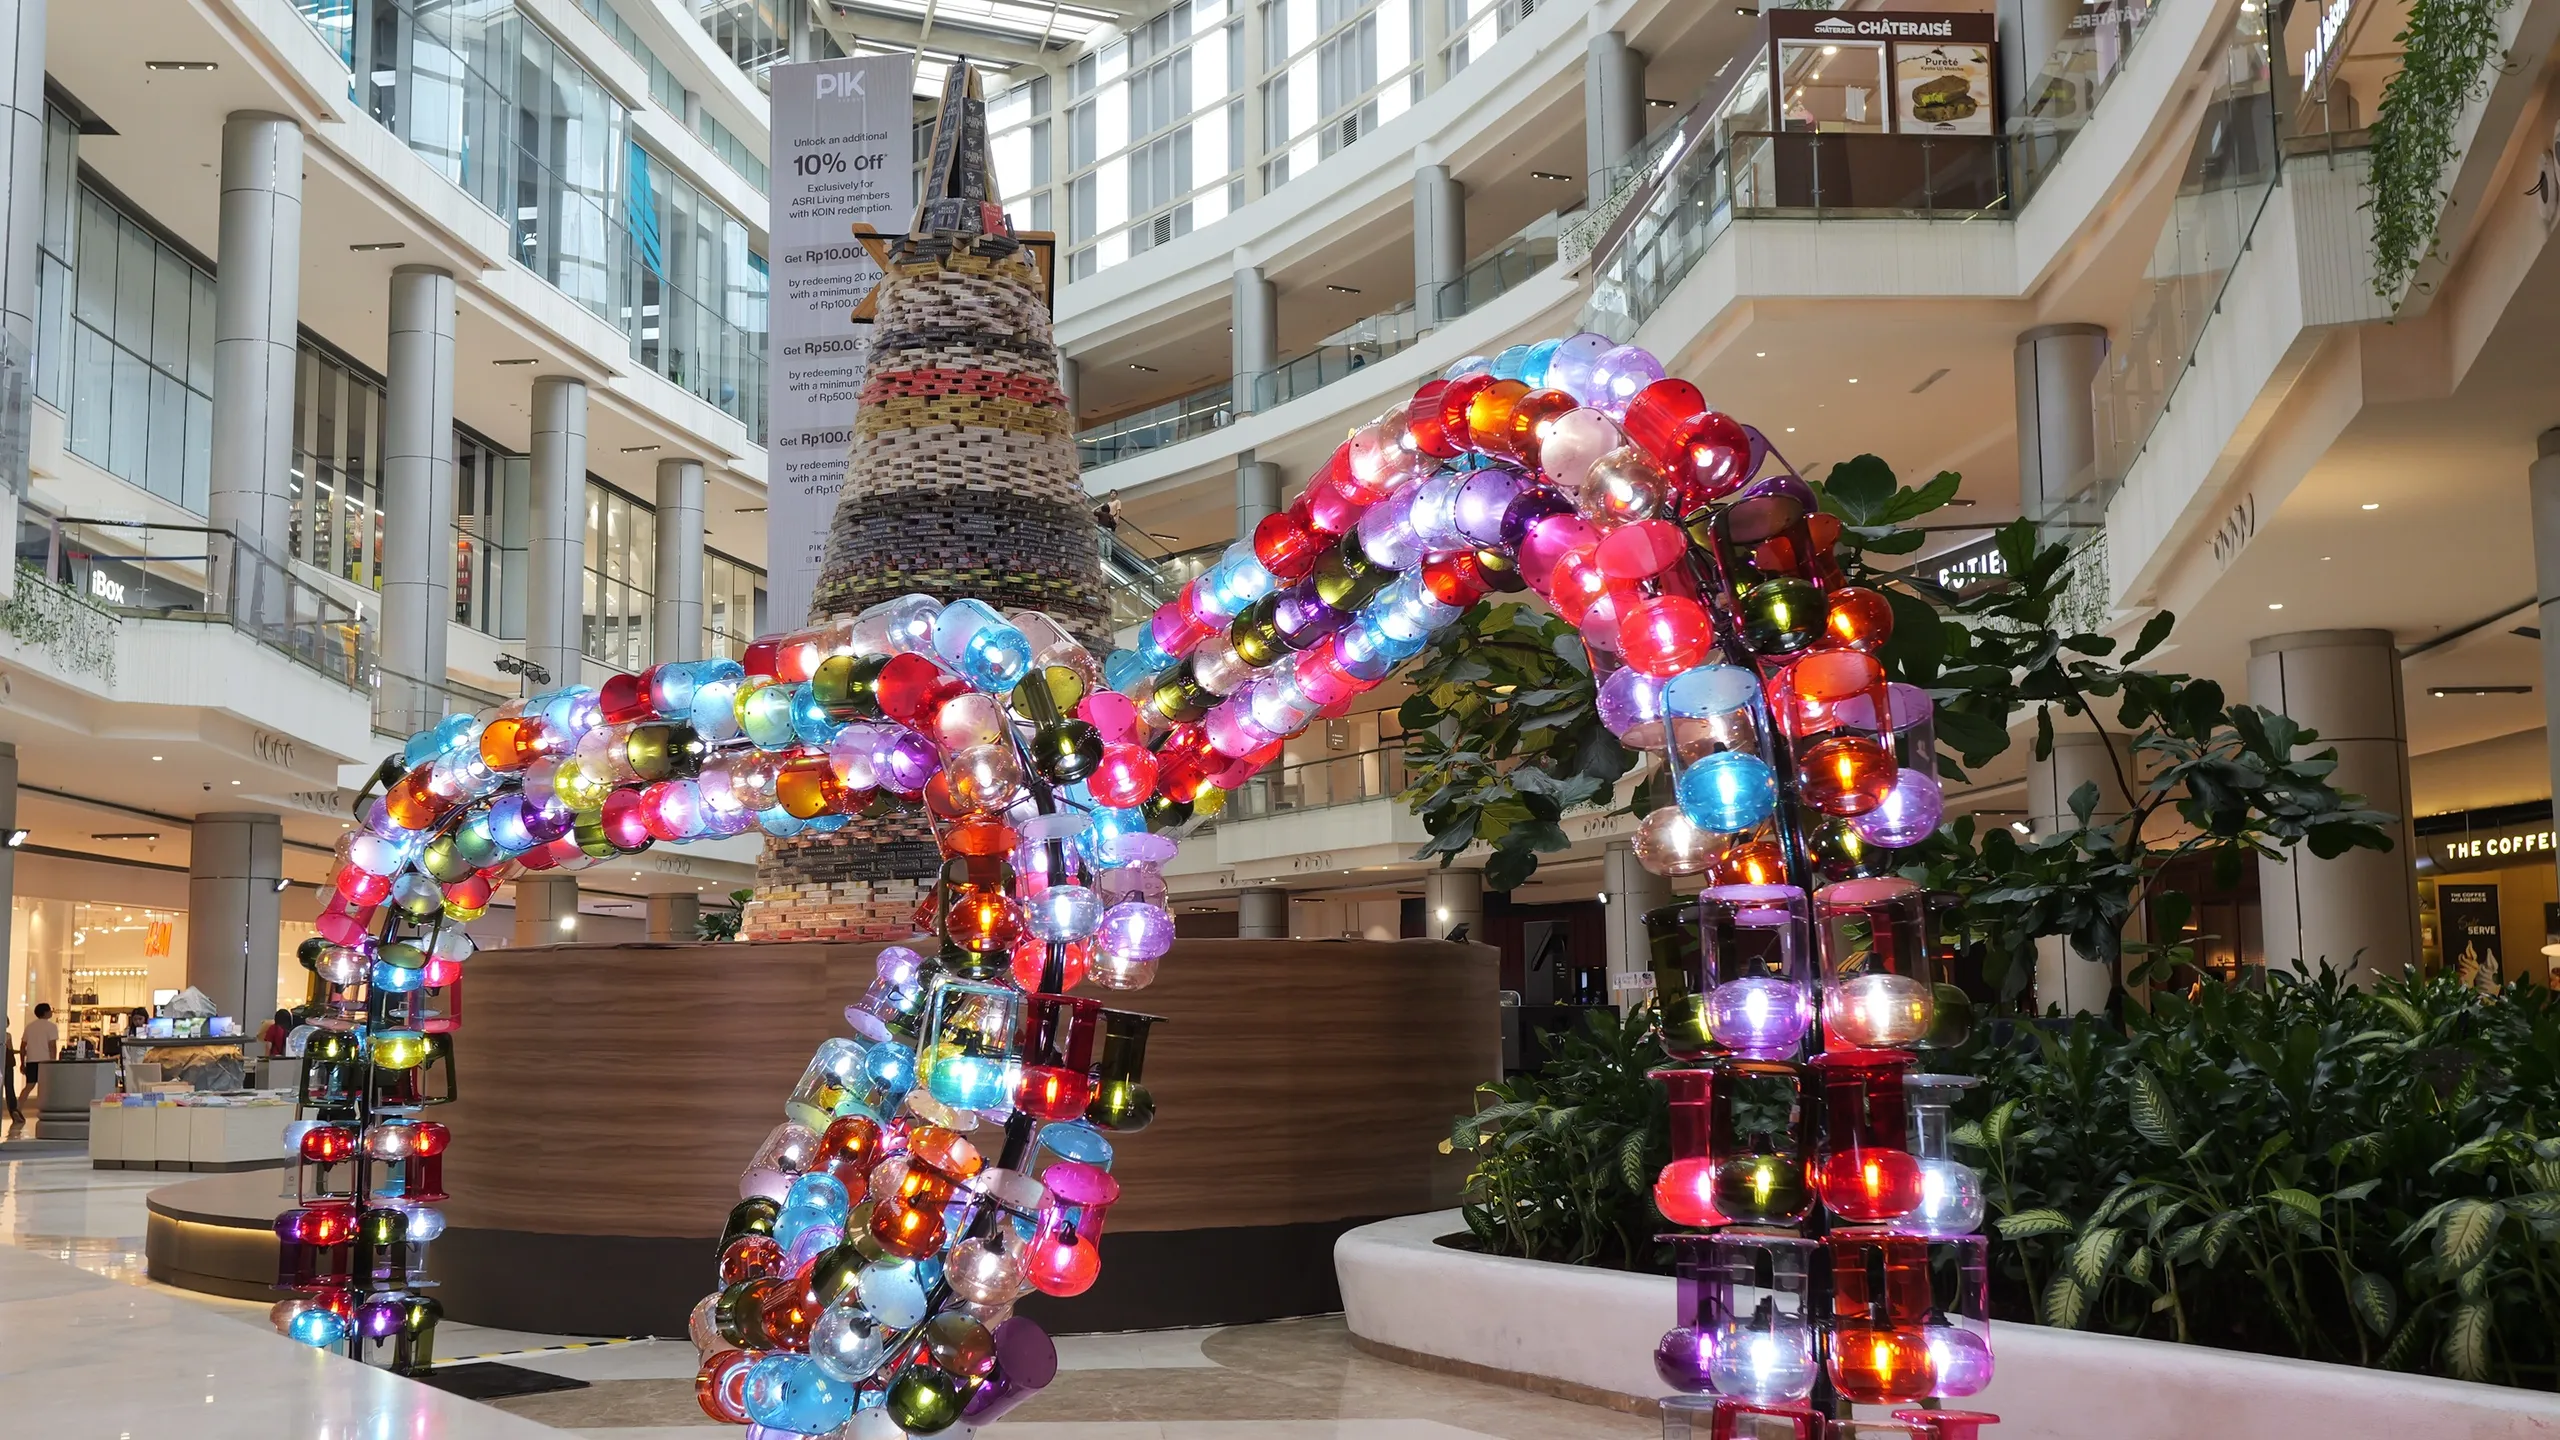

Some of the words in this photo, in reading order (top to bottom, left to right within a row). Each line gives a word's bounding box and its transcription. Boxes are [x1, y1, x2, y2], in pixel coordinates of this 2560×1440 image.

[1857, 18, 1952, 36] CHÂTERAISÉ
[816, 70, 865, 99] PIK
[794, 137, 826, 147] Unlock
[843, 131, 888, 142] additional
[794, 152, 846, 176] 10%
[808, 181, 859, 192] Exclusively
[860, 180, 874, 188] for
[792, 196, 815, 206] ASRI
[817, 195, 844, 204] Living
[847, 192, 890, 202] members
[789, 209, 809, 218] with
[812, 207, 835, 217] KOIN
[838, 203, 893, 215] redemption.
[784, 255, 802, 264] Get
[789, 279, 800, 288] by
[803, 275, 852, 286] redeeming
[854, 272, 866, 281] 20
[869, 271, 883, 280] KO
[790, 290, 810, 299] with
[820, 287, 860, 297] minimum
[809, 302, 818, 311] of
[783, 346, 801, 355] Get
[789, 371, 801, 380] by
[803, 367, 853, 378] redeeming
[789, 383, 810, 391] with
[820, 379, 860, 389] minimum
[808, 394, 817, 402] of
[780, 437, 798, 447] Get
[786, 463, 798, 472] by
[800, 459, 850, 470] redeeming
[789, 474, 809, 483] with
[804, 486, 814, 495] of
[92, 570, 125, 604] iBox
[2447, 840, 2481, 859] THE
[2467, 926, 2496, 935] SERVE
